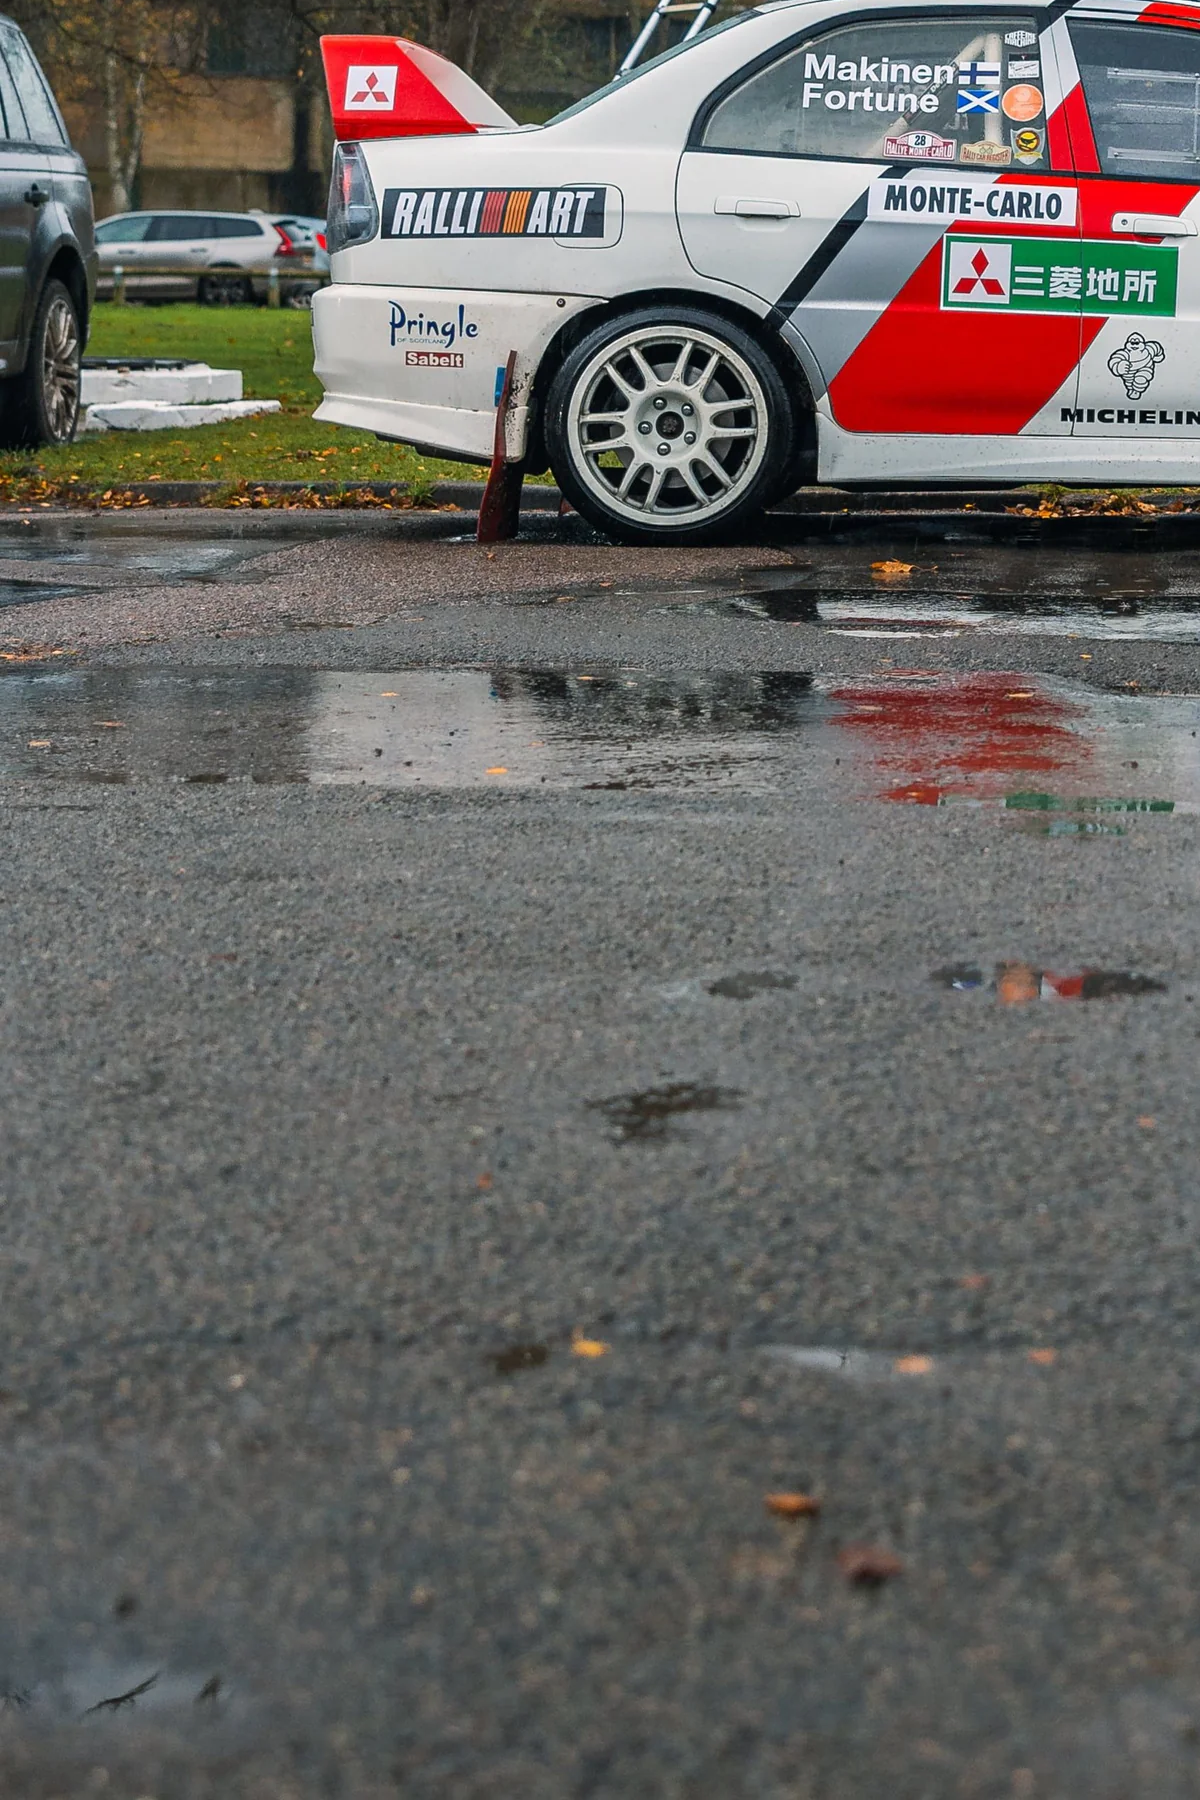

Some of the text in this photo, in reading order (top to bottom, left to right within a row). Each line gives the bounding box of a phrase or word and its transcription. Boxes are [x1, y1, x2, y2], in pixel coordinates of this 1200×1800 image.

[804, 53, 954, 84] Makinen
[802, 82, 939, 113] Fortune
[886, 140, 908, 155] RALLYE
[909, 145, 953, 158] MONTE-CARLO
[914, 135, 926, 146] 28
[884, 184, 1062, 220] MONTE-CARLO
[1012, 266, 1157, 303] 三菱地所
[388, 300, 478, 348] Pringle
[407, 352, 462, 367] Sabelt
